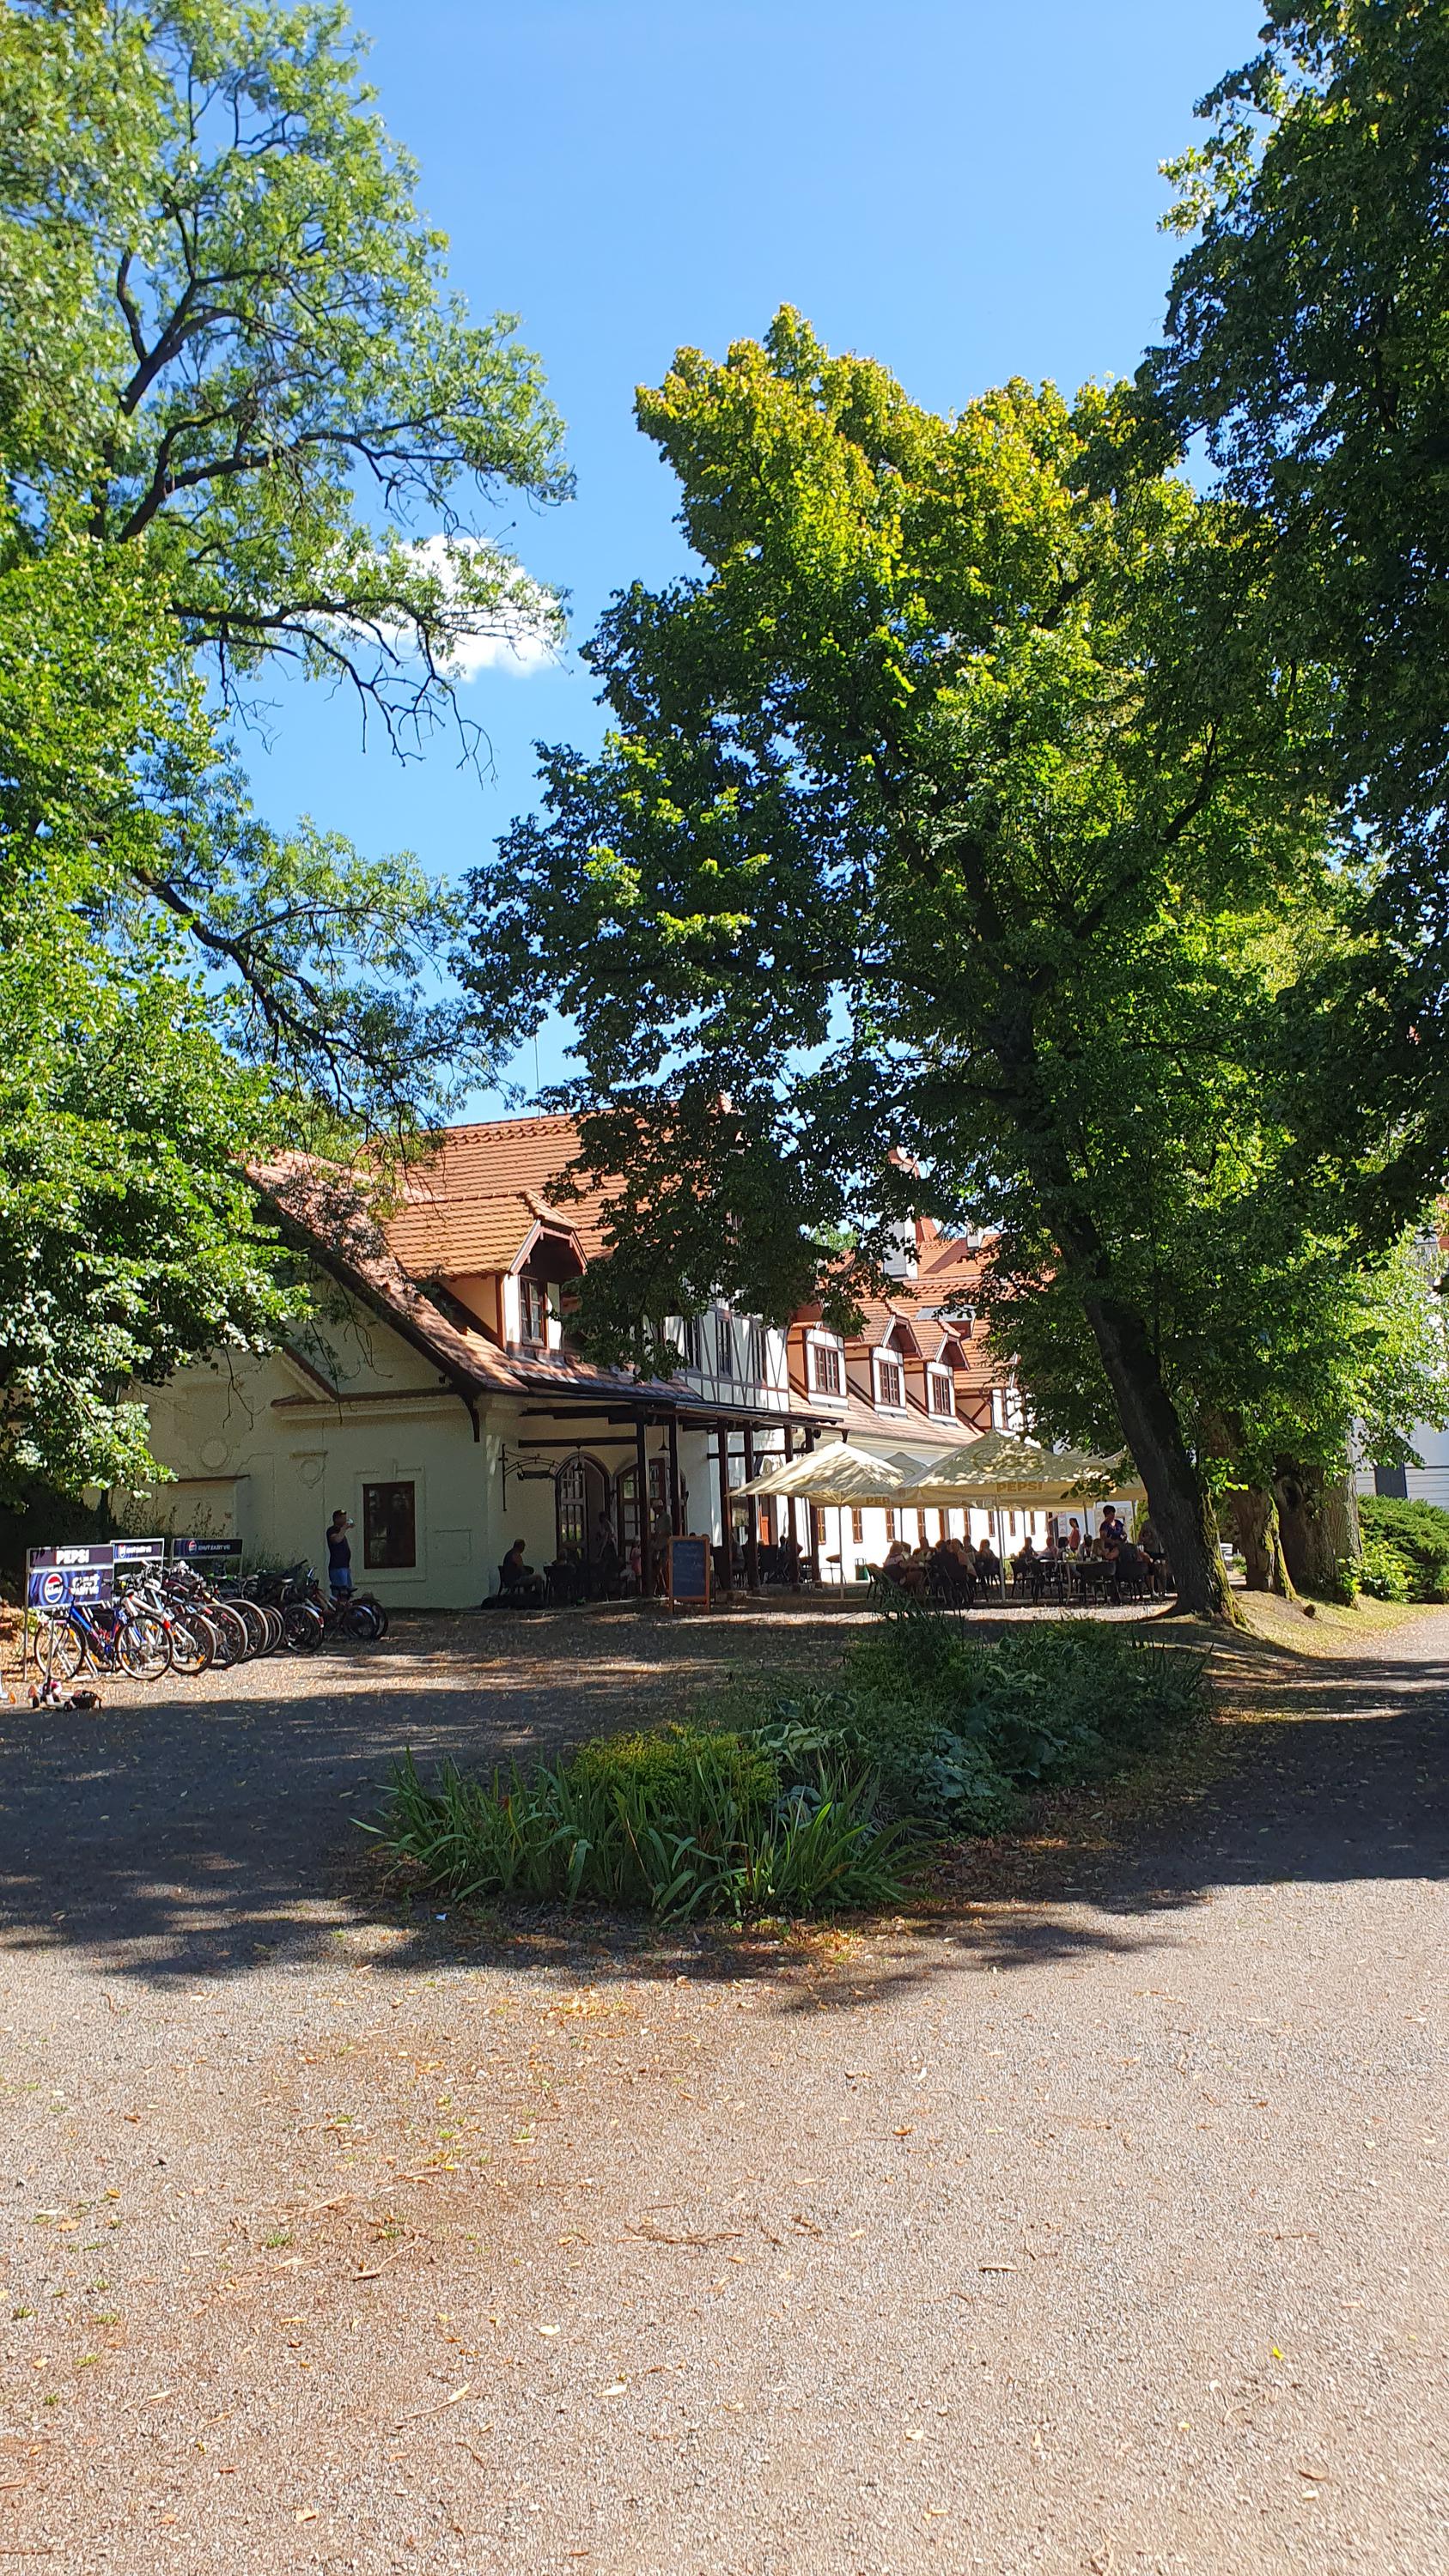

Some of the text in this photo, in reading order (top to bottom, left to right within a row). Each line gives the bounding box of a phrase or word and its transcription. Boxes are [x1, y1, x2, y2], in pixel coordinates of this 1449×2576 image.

[996, 1481, 1044, 1493] PEPSI
[865, 1496, 891, 1505] PEP
[56, 1549, 90, 1564] PEPSI
